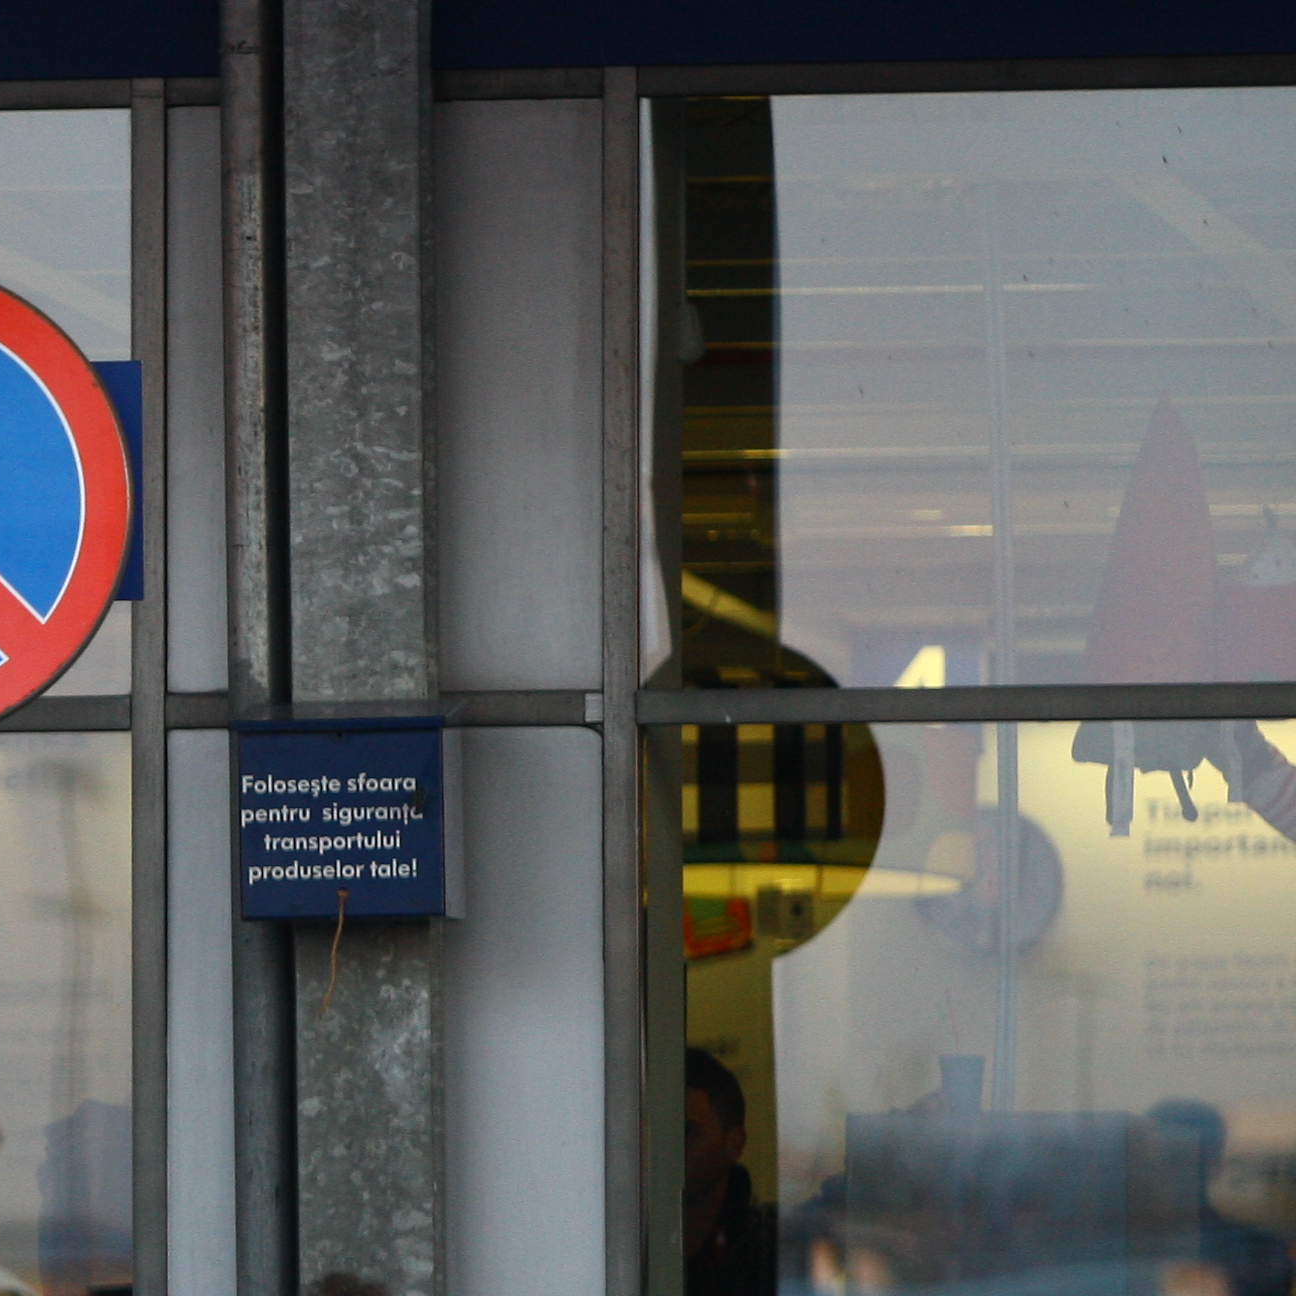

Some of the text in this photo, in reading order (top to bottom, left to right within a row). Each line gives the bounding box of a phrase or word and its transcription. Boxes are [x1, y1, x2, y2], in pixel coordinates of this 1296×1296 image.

[347, 773, 417, 792] sfoara
[241, 804, 310, 828] pentru
[264, 830, 401, 855] transportului
[248, 858, 417, 885] produselor tale!
